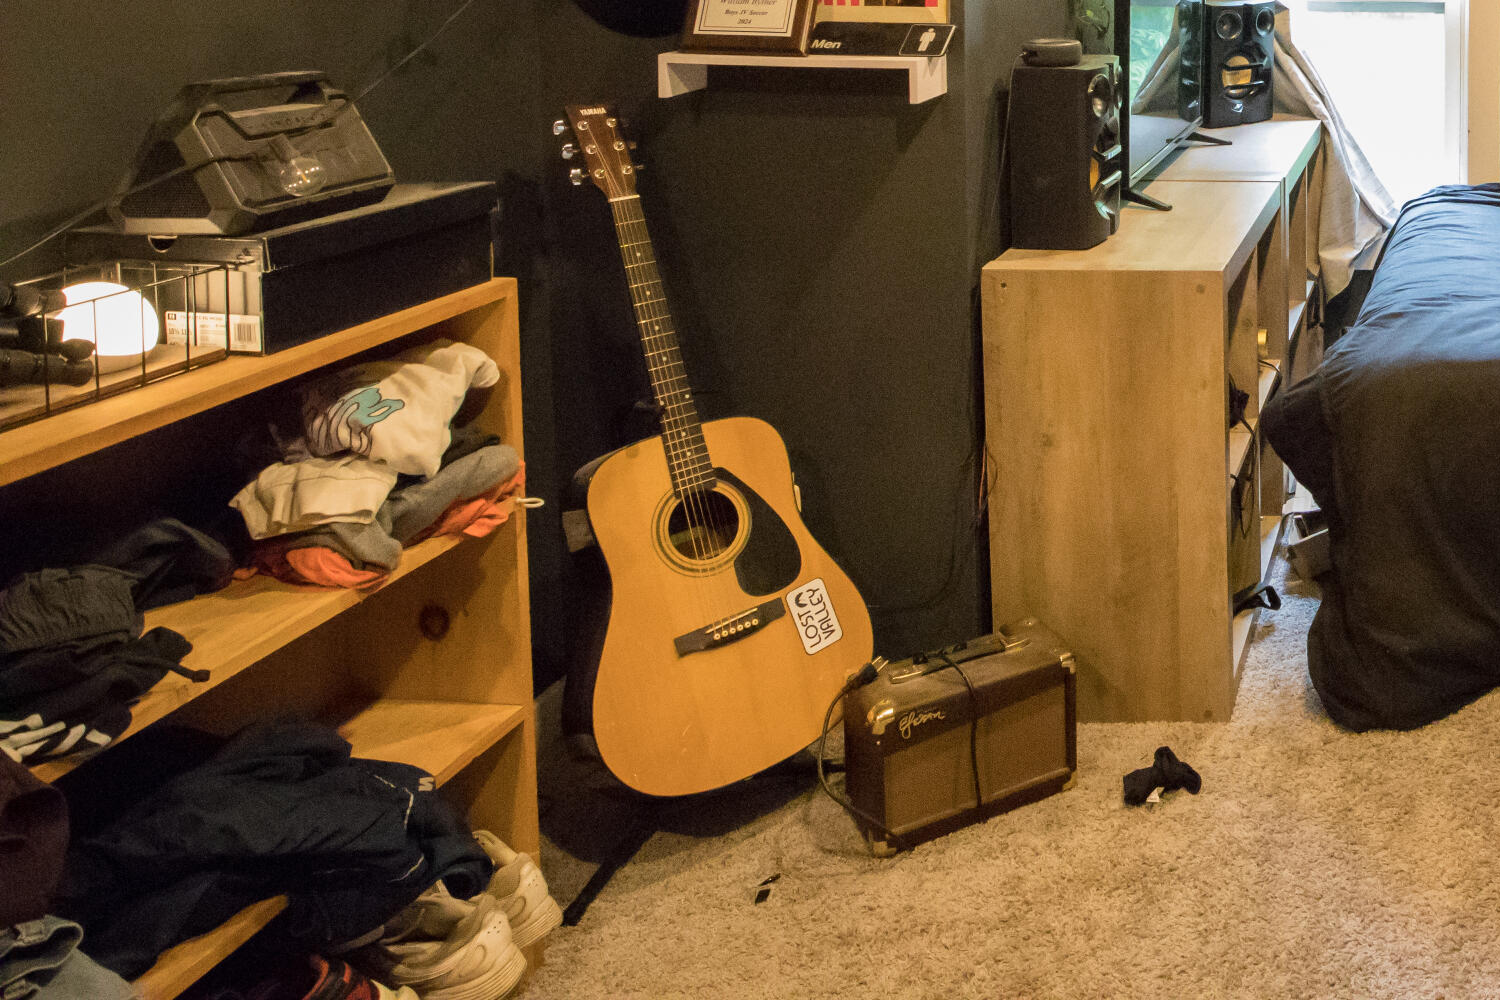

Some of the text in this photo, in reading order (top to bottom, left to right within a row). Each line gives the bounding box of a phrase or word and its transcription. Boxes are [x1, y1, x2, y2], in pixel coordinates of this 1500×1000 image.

[811, 39, 842, 49] Men
[580, 107, 607, 116] YAMAHA
[806, 588, 836, 640] VALLEY
[797, 610, 821, 648] LOST
